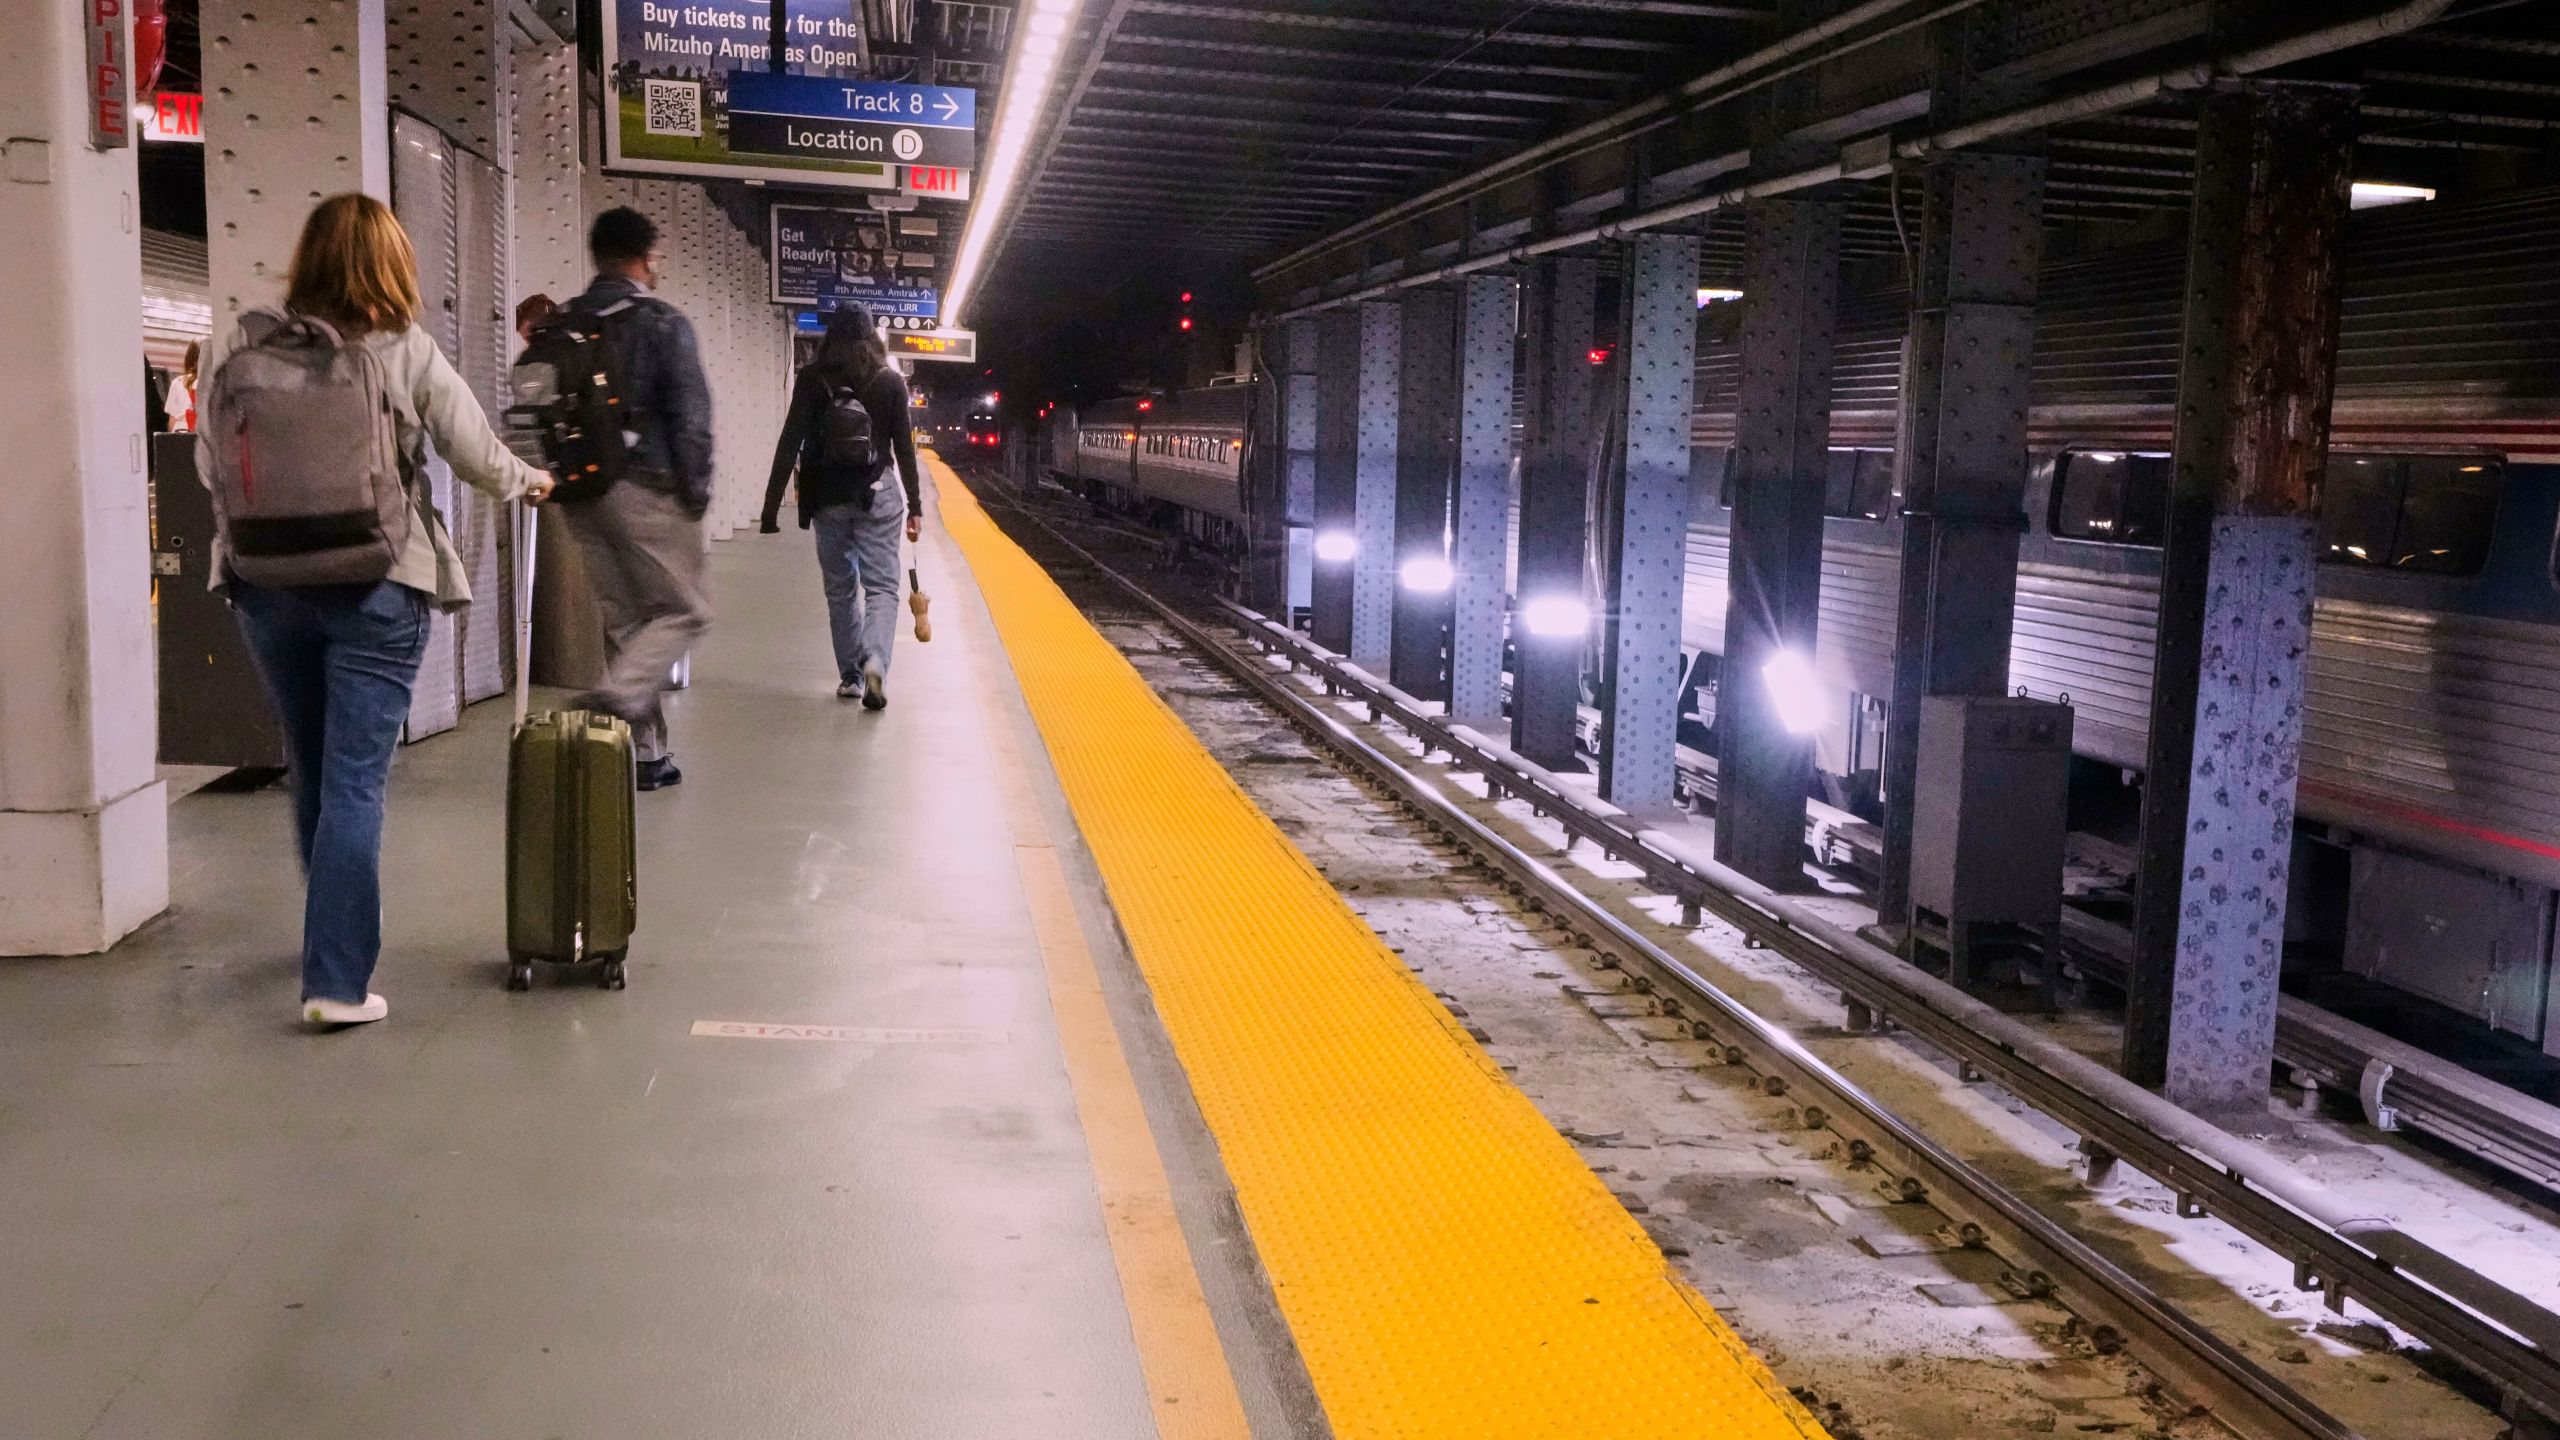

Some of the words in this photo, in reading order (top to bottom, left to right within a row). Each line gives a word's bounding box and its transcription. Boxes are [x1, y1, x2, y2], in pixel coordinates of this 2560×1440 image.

[643, 2, 678, 28] Buy
[684, 6, 746, 30] tickets
[796, 15, 822, 35] for
[828, 18, 857, 38] the
[644, 32, 713, 56] Mizuho
[719, 38, 804, 63] Ameras
[810, 44, 857, 69] Open
[842, 88, 900, 113] Track
[909, 94, 924, 114] 8
[787, 125, 883, 153] Location
[781, 227, 805, 242] Get
[782, 246, 830, 264] Ready!
[835, 285, 850, 294] 8th
[852, 286, 884, 296] Avenue,
[887, 288, 918, 298] Amtrak
[863, 301, 897, 313] Subway,
[899, 303, 918, 312] LIRR
[719, 1024, 867, 1039] STAND
